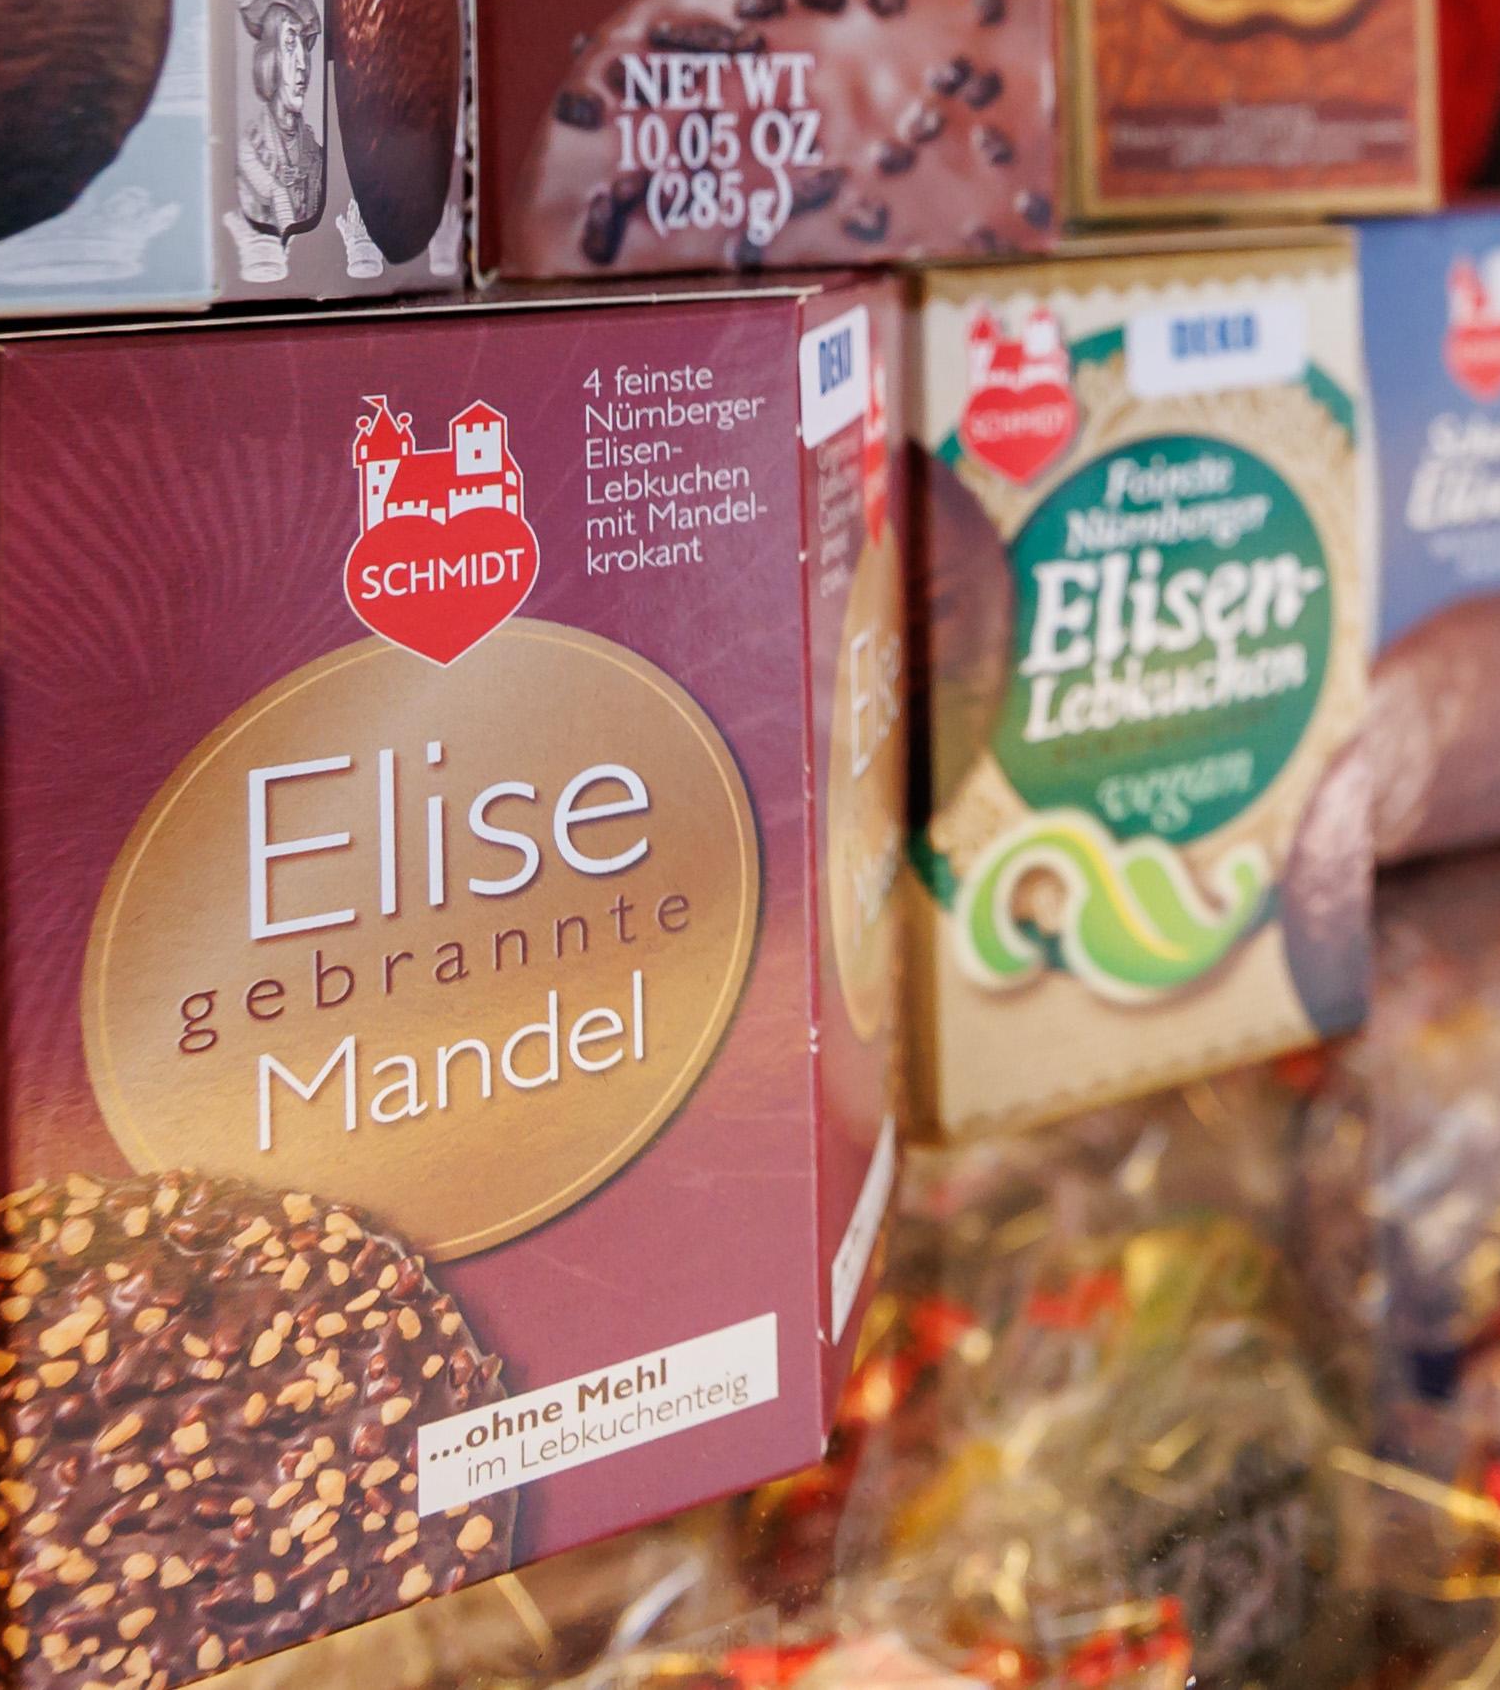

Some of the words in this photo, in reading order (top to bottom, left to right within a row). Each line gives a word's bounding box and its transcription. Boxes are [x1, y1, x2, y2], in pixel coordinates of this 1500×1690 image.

[619, 51, 732, 109] NET
[733, 52, 817, 109] WT
[617, 112, 741, 171] 10.05
[750, 109, 824, 169] OZ
[1169, 313, 1260, 360] DEKO
[583, 367, 603, 399] 4
[614, 363, 714, 397] feinste
[585, 396, 766, 434] Nürnberger
[586, 436, 683, 470] Elisen-
[587, 462, 750, 505] Lebkuchen
[587, 506, 637, 541] mit
[649, 490, 768, 534] Mandel-
[359, 546, 526, 601] SCHMIDT
[587, 534, 705, 577] krokant
[1019, 547, 1326, 675] Elisen-
[1023, 638, 1308, 743] Lebkuchen
[247, 741, 651, 941] Elise
[178, 890, 692, 1055] gebrannte
[256, 967, 647, 1154] Mandel
[430, 1401, 563, 1462] ...ohne
[577, 1357, 668, 1415] Mehl
[467, 1456, 507, 1487] im
[520, 1372, 749, 1470] Lebkuchenteig
